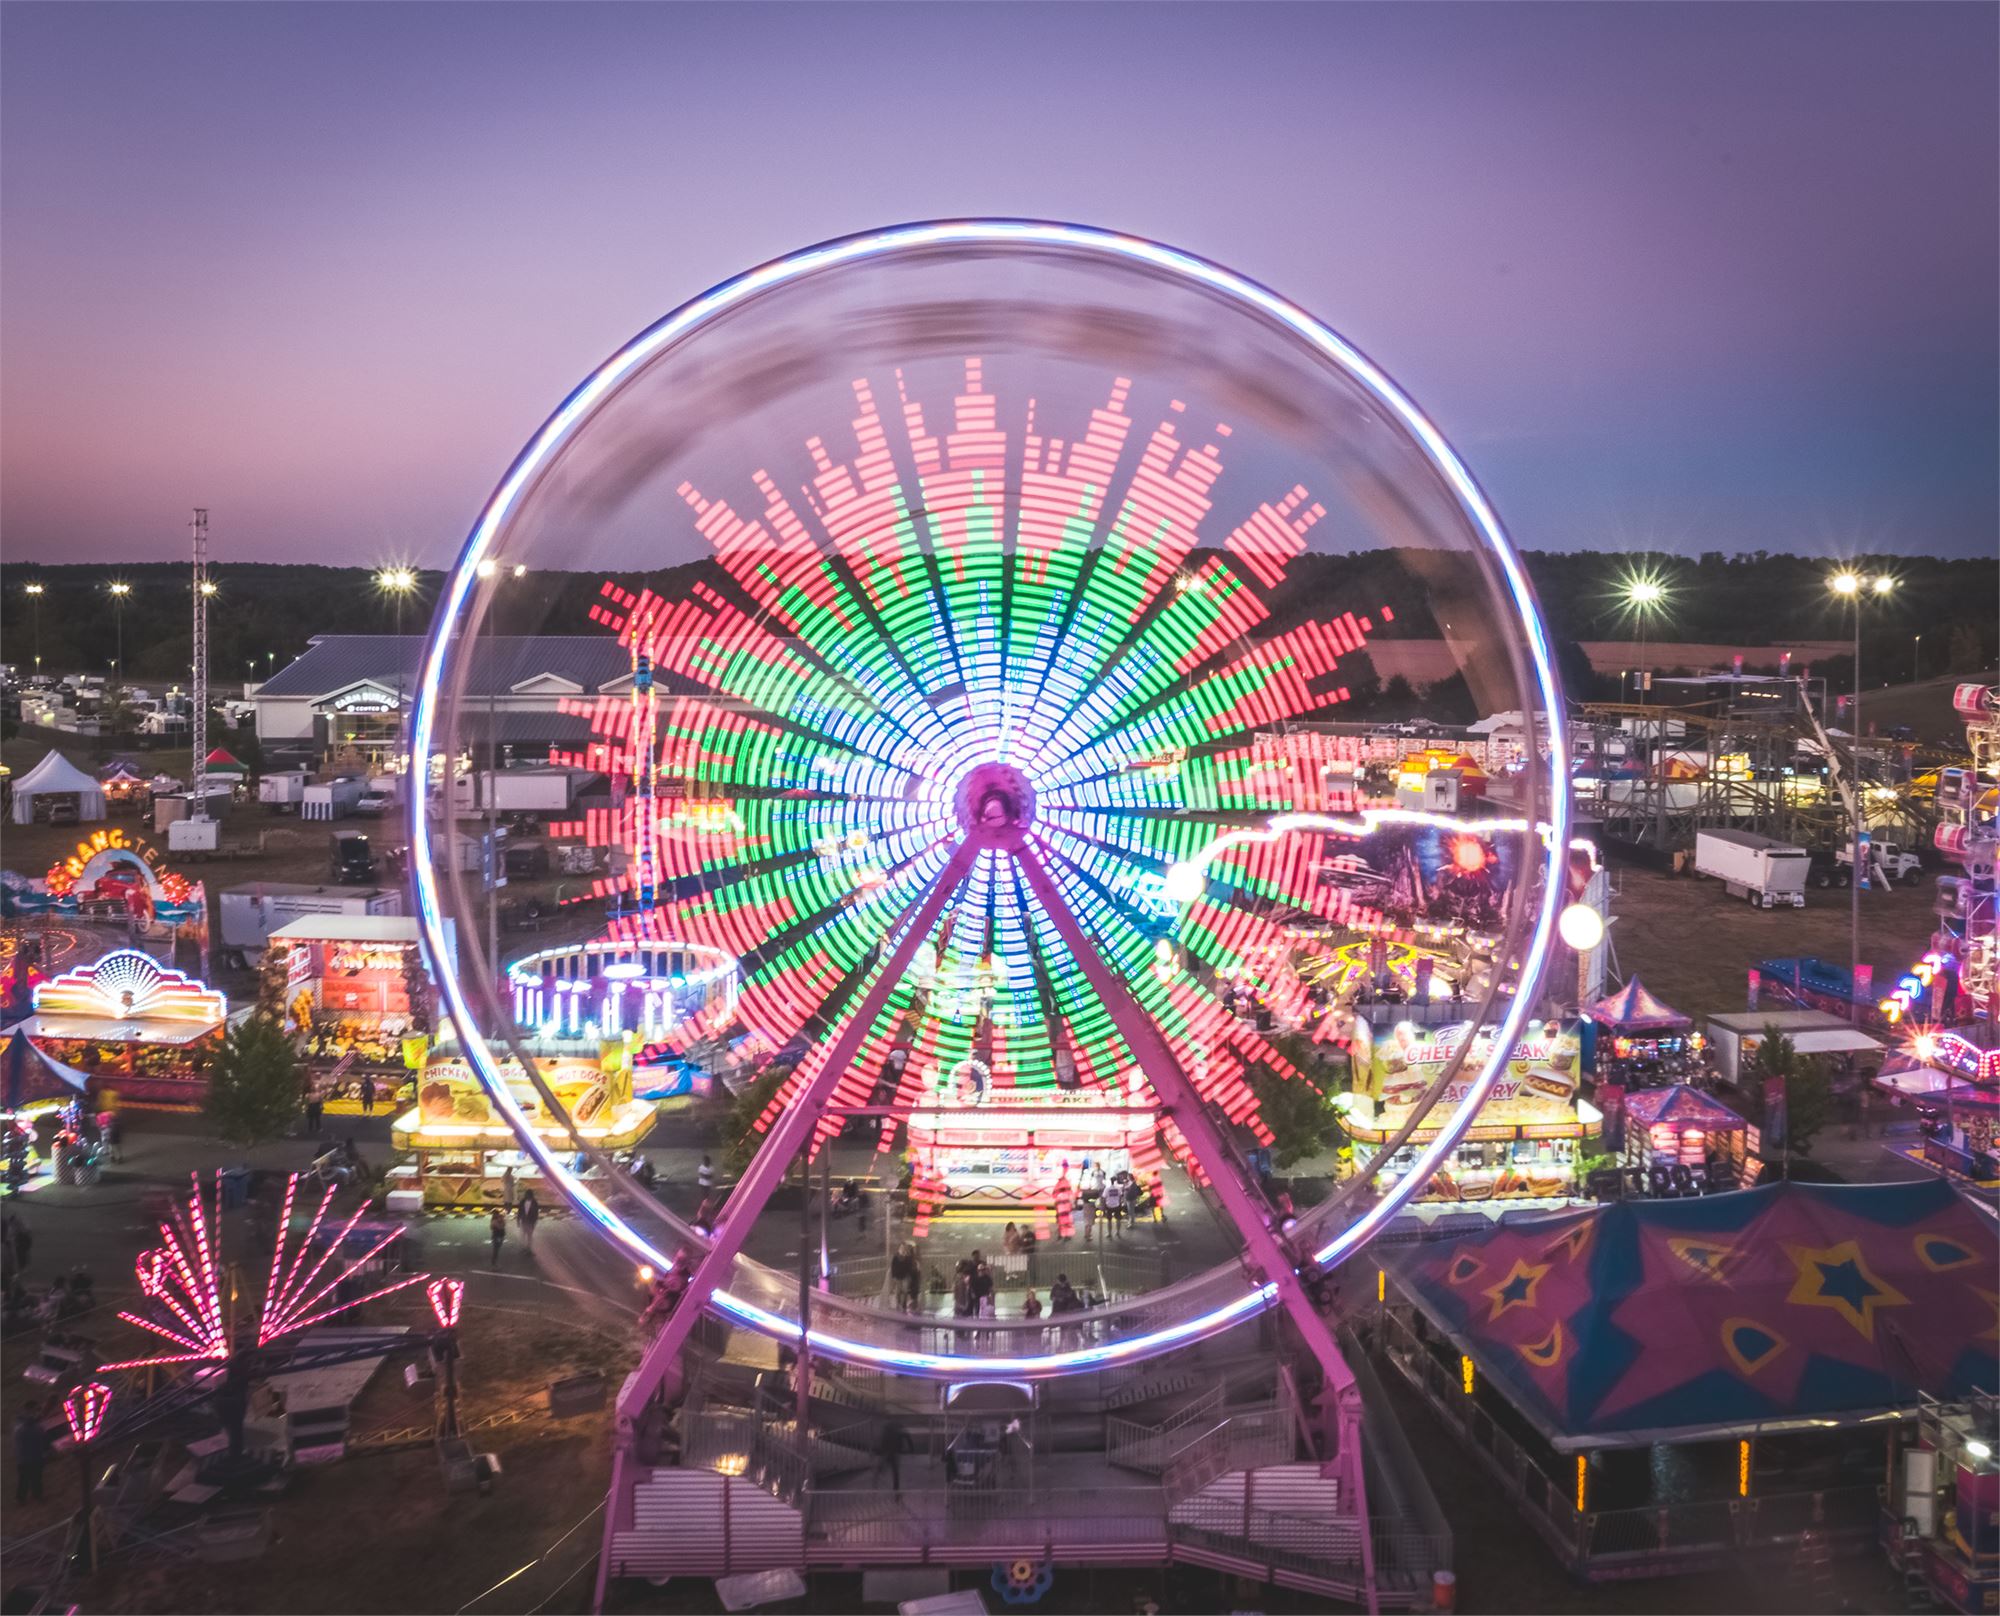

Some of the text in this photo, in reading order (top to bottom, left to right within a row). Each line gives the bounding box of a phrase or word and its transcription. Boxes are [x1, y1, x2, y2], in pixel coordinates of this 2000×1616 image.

[335, 692, 399, 709] FARM BUREAU
[423, 1065, 470, 1081] CHICKEN
[556, 1069, 608, 1085] HOT DOGS
